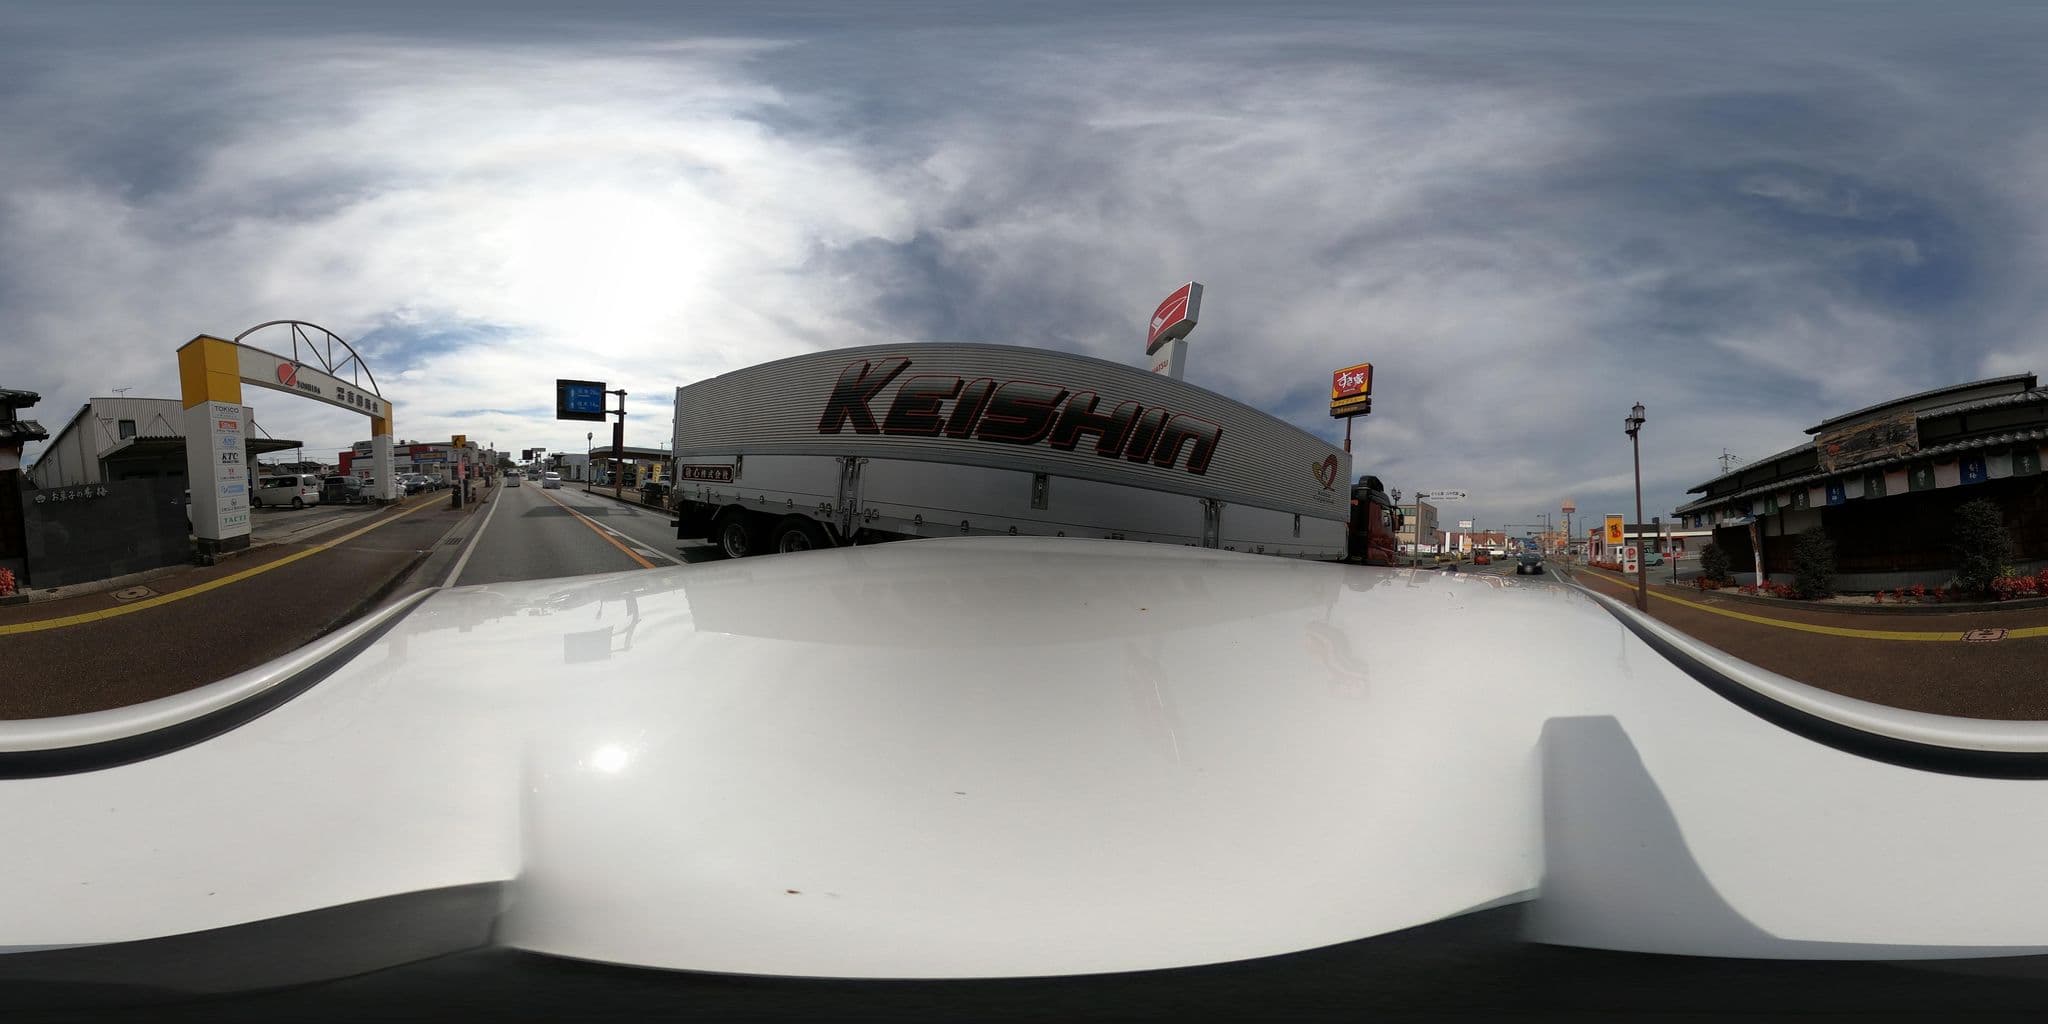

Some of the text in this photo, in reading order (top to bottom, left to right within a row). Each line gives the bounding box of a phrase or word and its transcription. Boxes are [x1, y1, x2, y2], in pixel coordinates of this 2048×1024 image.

[1337, 372, 1365, 388] すき家
[214, 406, 240, 414] TOKICO
[817, 356, 1222, 476] KEISHIN
[222, 452, 239, 461] KTC
